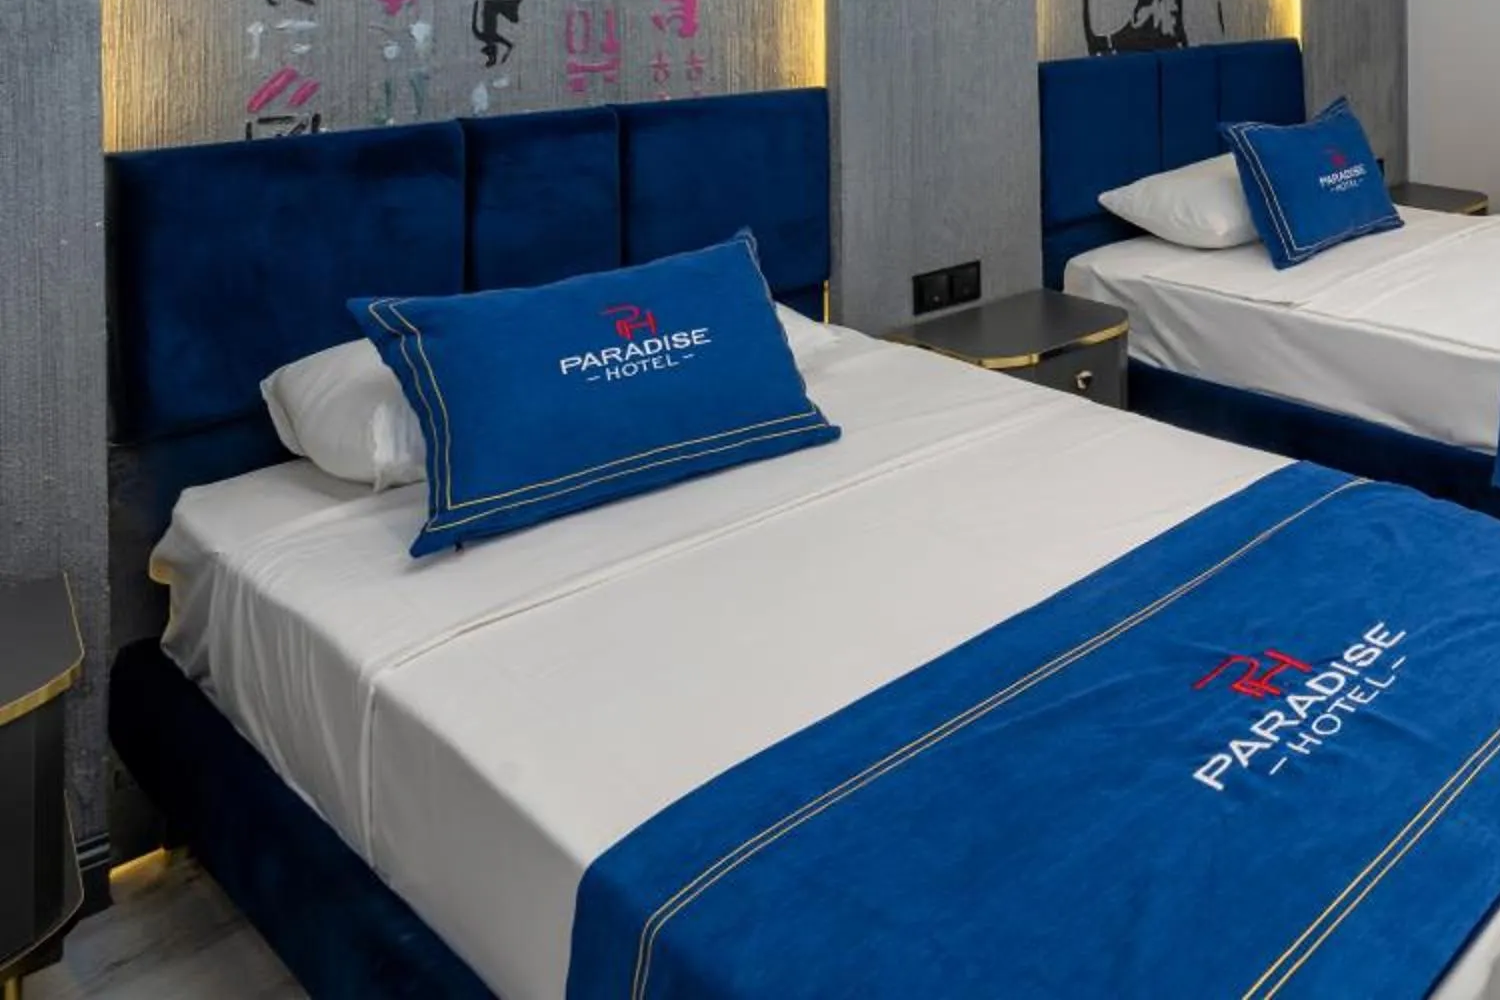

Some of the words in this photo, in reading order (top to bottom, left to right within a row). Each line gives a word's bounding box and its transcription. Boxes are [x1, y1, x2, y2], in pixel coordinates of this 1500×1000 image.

[559, 327, 712, 375] PARADISE
[605, 354, 679, 381] HOTEL
[1192, 621, 1407, 791] PARADISE
[1286, 674, 1397, 755] HOTEL
